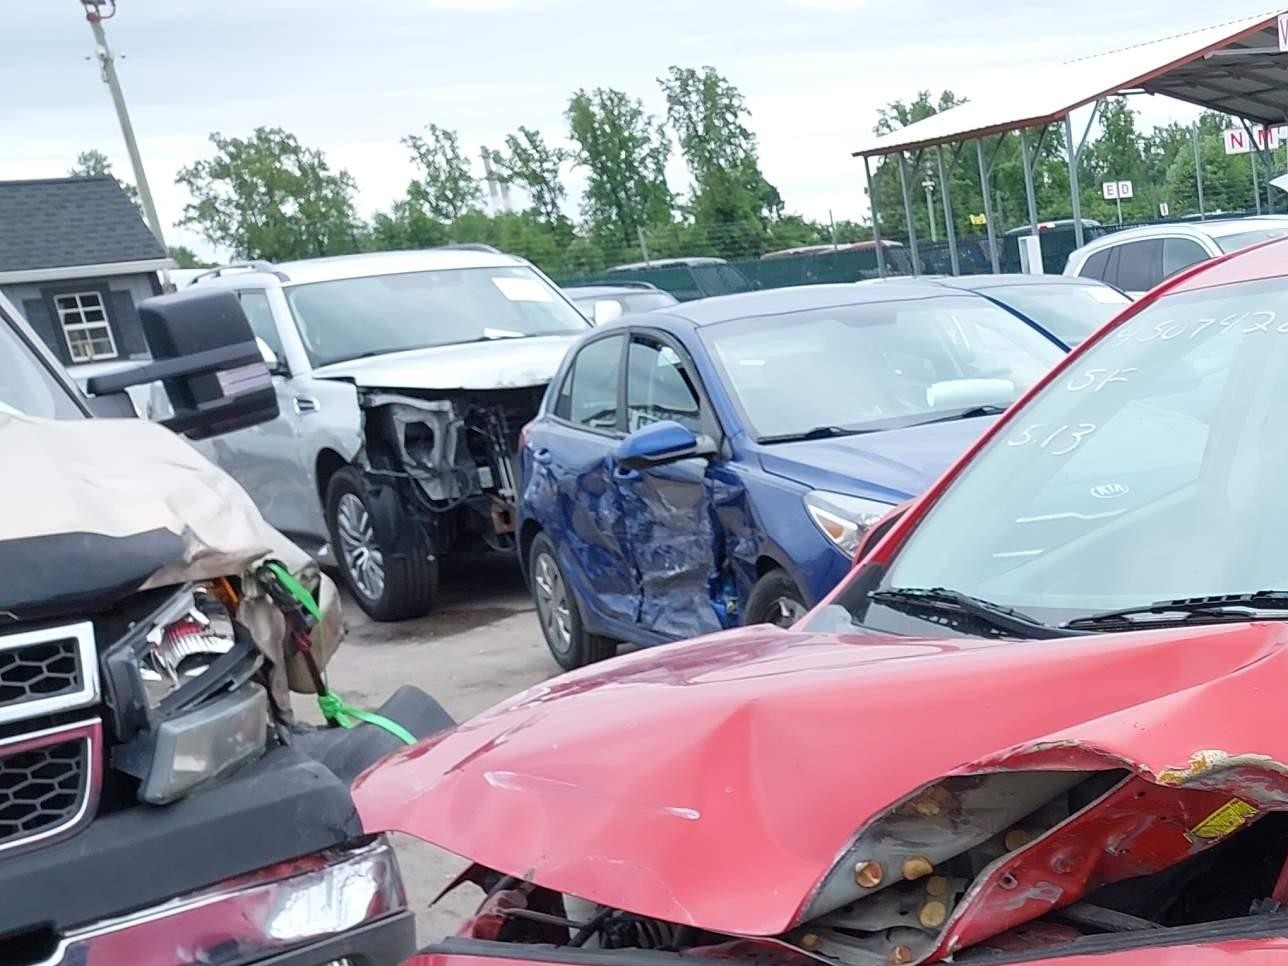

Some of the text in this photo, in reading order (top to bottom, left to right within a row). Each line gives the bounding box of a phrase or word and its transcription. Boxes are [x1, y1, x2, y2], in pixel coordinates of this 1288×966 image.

[1230, 132, 1243, 150] N
[1106, 184, 1114, 196] E
[1121, 183, 1129, 195] D
